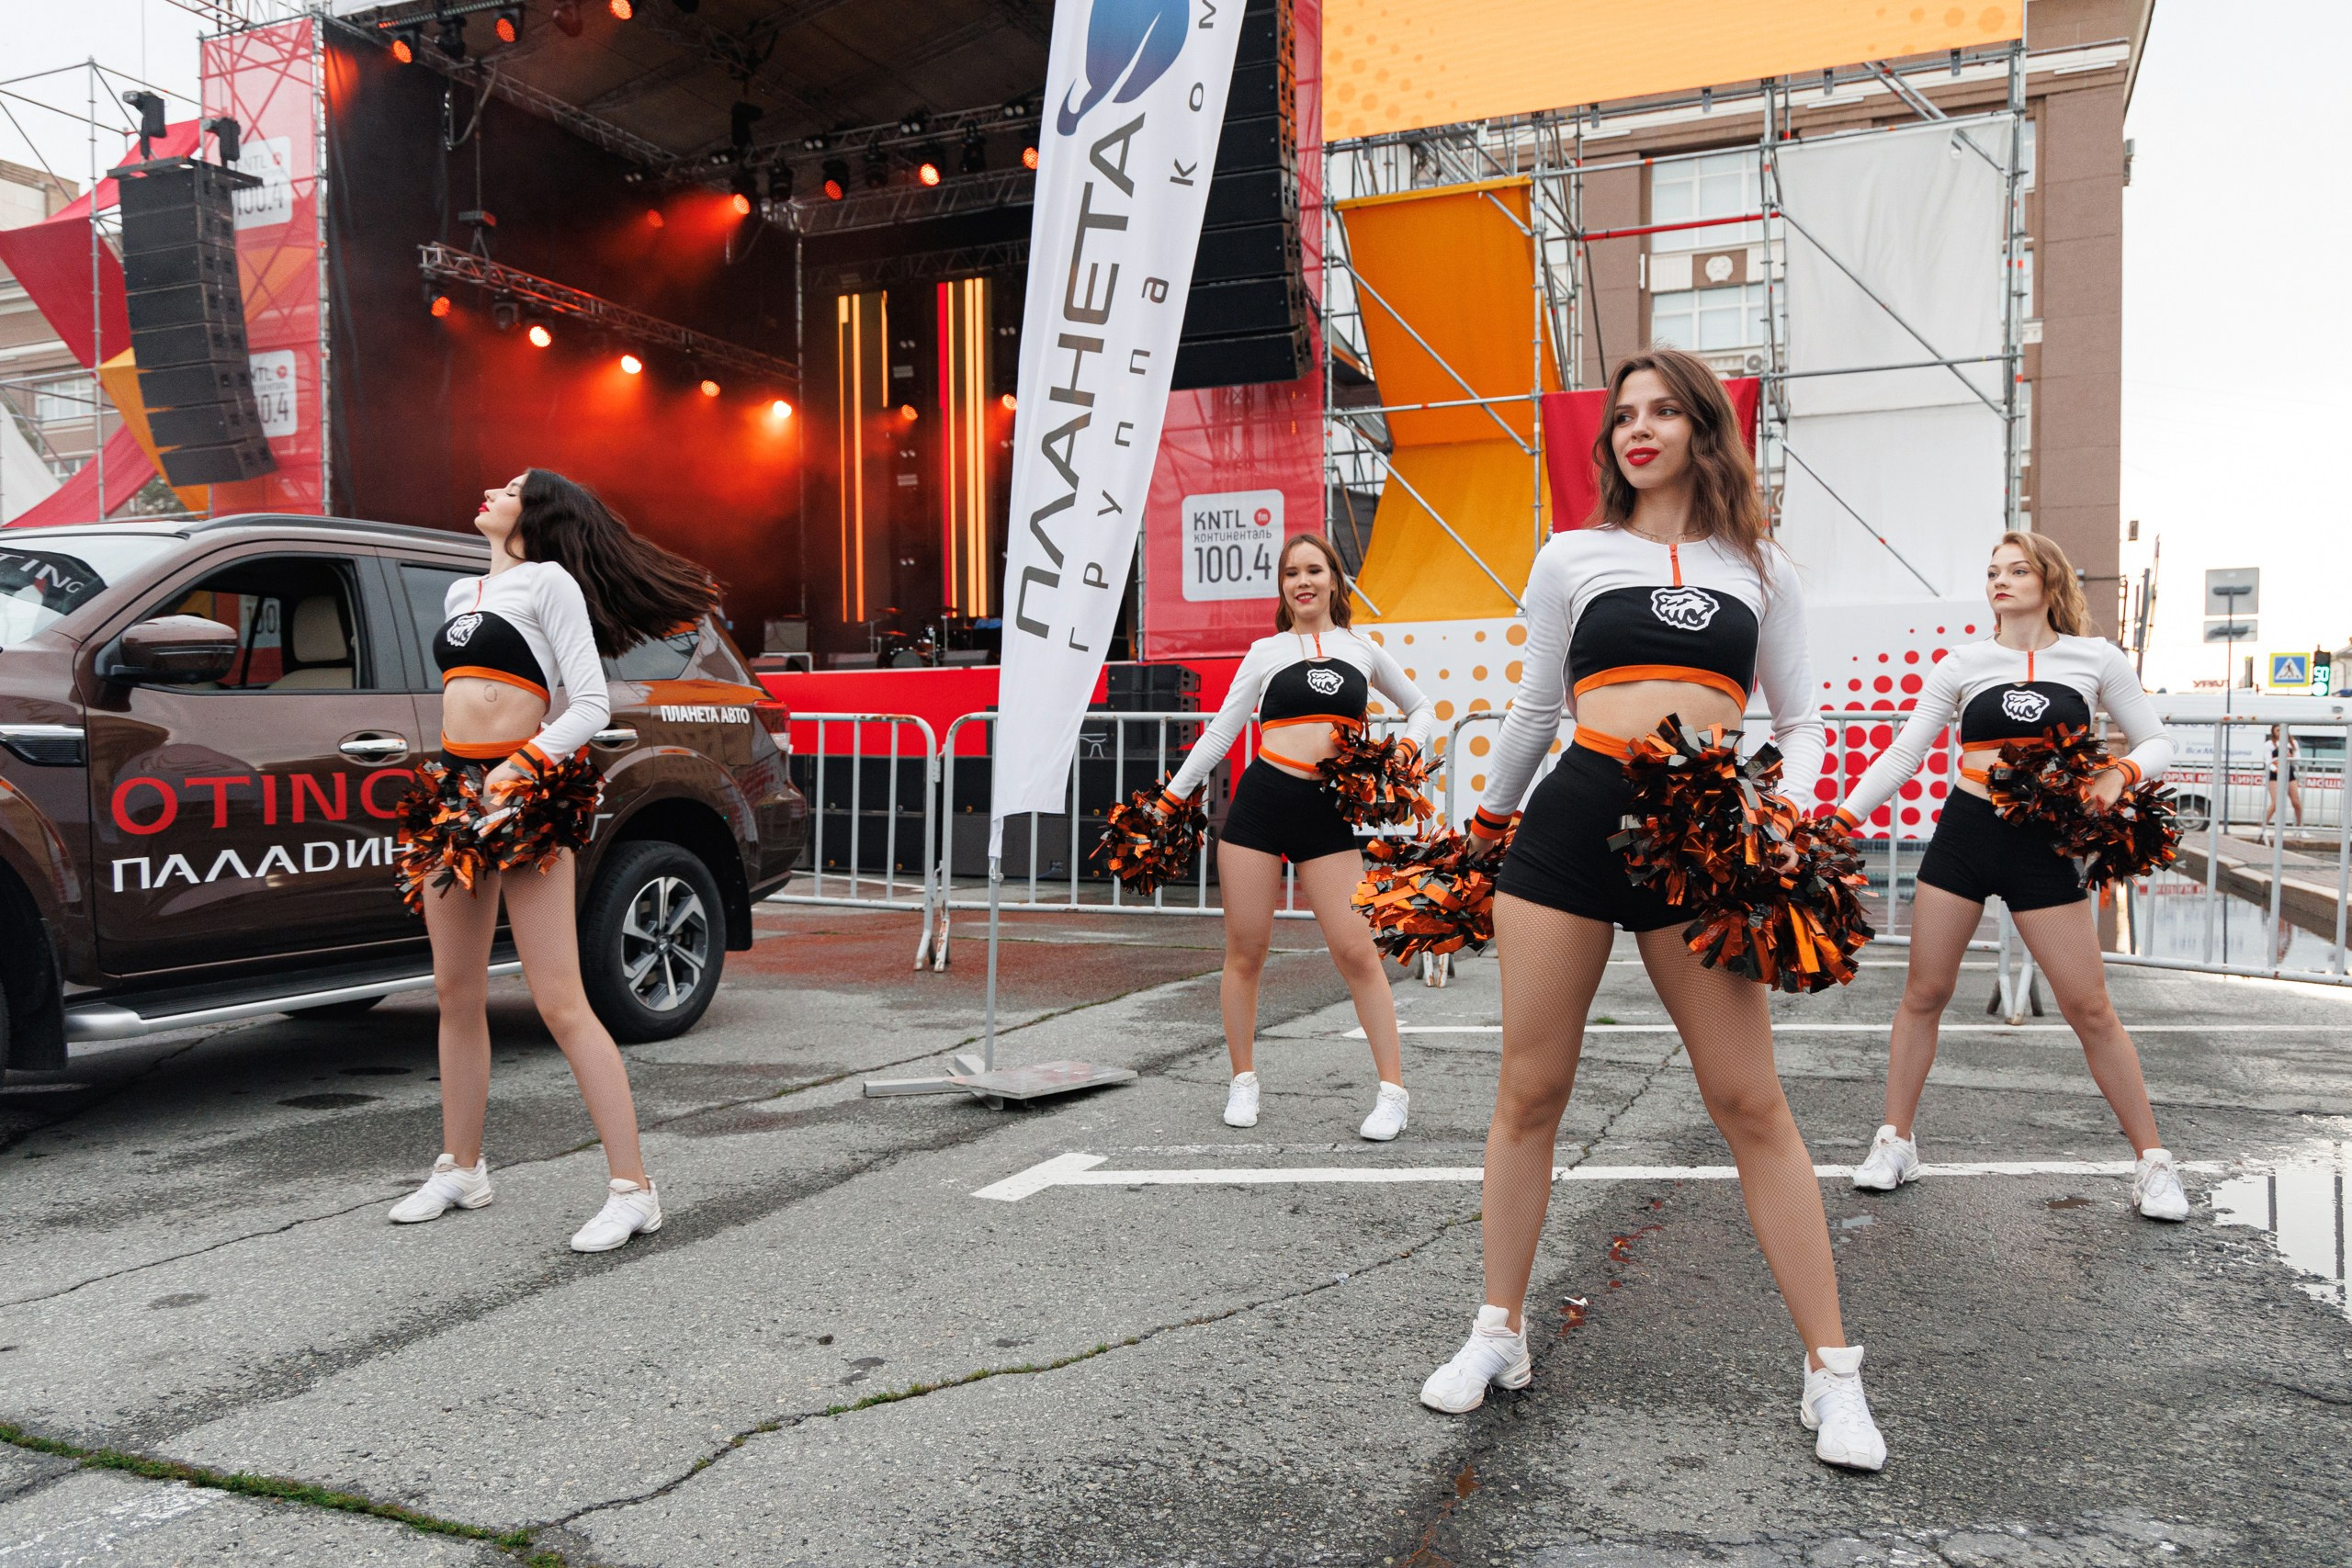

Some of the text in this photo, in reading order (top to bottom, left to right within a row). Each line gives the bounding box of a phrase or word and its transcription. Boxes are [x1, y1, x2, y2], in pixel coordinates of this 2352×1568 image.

[1016, 111, 1146, 639] ПЛАНЕТА
[260, 392, 289, 424] 0.4
[1193, 509, 1247, 531] KNTL
[1194, 543, 1272, 583] 100.4
[661, 705, 751, 724] ПЛАНЕТА АВТО
